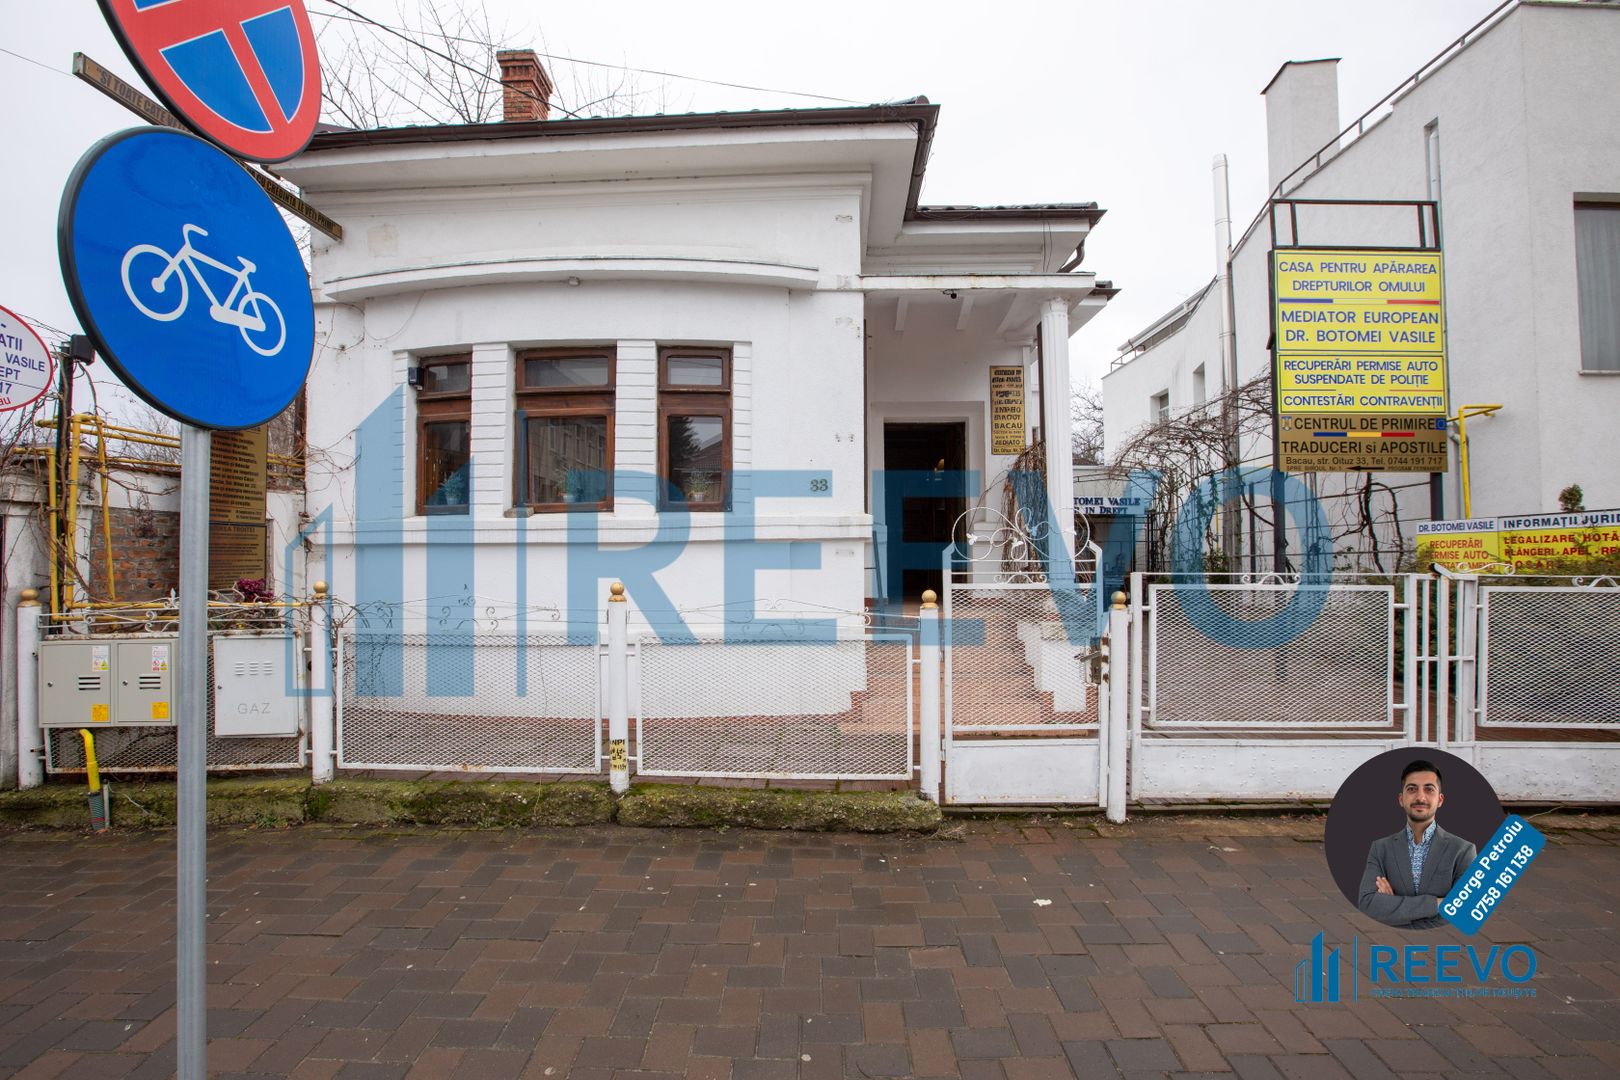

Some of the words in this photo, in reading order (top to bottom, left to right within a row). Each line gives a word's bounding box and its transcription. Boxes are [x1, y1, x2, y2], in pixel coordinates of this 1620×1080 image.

[114, 76, 143, 107] TOATE
[144, 97, 166, 122] CATE
[1279, 262, 1314, 273] CASA
[1320, 262, 1367, 274] PENTRU
[1373, 260, 1437, 274] APĂRAREA
[1292, 280, 1372, 292] DREPTURILOR
[1378, 281, 1425, 293] OMULUI
[1281, 311, 1356, 323] MEDIATOR
[1363, 311, 1439, 324] EUROPEAN
[1285, 330, 1309, 342] DR.
[1316, 330, 1381, 343] BOTOMEI
[1388, 331, 1435, 343] VASILE
[5, 352, 46, 373] VASILE
[1284, 358, 1352, 371] RECUPERĂRI
[1356, 361, 1402, 371] PERMISE
[1406, 361, 1438, 371] AUTO
[1294, 375, 1366, 385] SUSPENDATE
[1371, 375, 1386, 385] DE
[1390, 374, 1429, 388] POLIȚIE
[1283, 393, 1355, 406] CONTESTĂRI
[1360, 395, 1442, 409] CONTRAVENȚII
[1294, 418, 1356, 430] CENTRUL
[1360, 418, 1378, 430] DE
[1381, 418, 1435, 430] PRIMIRE
[1282, 441, 1362, 453] TRADUCERI
[1365, 441, 1376, 453] si
[1380, 441, 1447, 454] APOSTILE
[1286, 457, 1315, 466] Bacau,
[1317, 457, 1330, 465] str.
[1333, 457, 1354, 465] Oituz
[1371, 457, 1386, 465] Tel.
[1387, 457, 1408, 465] 0744
[1410, 457, 1425, 465] 191
[1427, 457, 1443, 465] 717
[810, 478, 829, 492] 33
[1108, 497, 1141, 506] VASILE
[1431, 522, 1465, 531] BOTOMEI
[1466, 520, 1494, 530] VASILE
[1503, 516, 1577, 528] INFORMAȚII
[1429, 537, 1482, 548] RECUPERĂRI
[1504, 534, 1575, 544] LEGALIZARE
[1463, 551, 1489, 560] AUTO
[237, 702, 272, 715] GAZ
